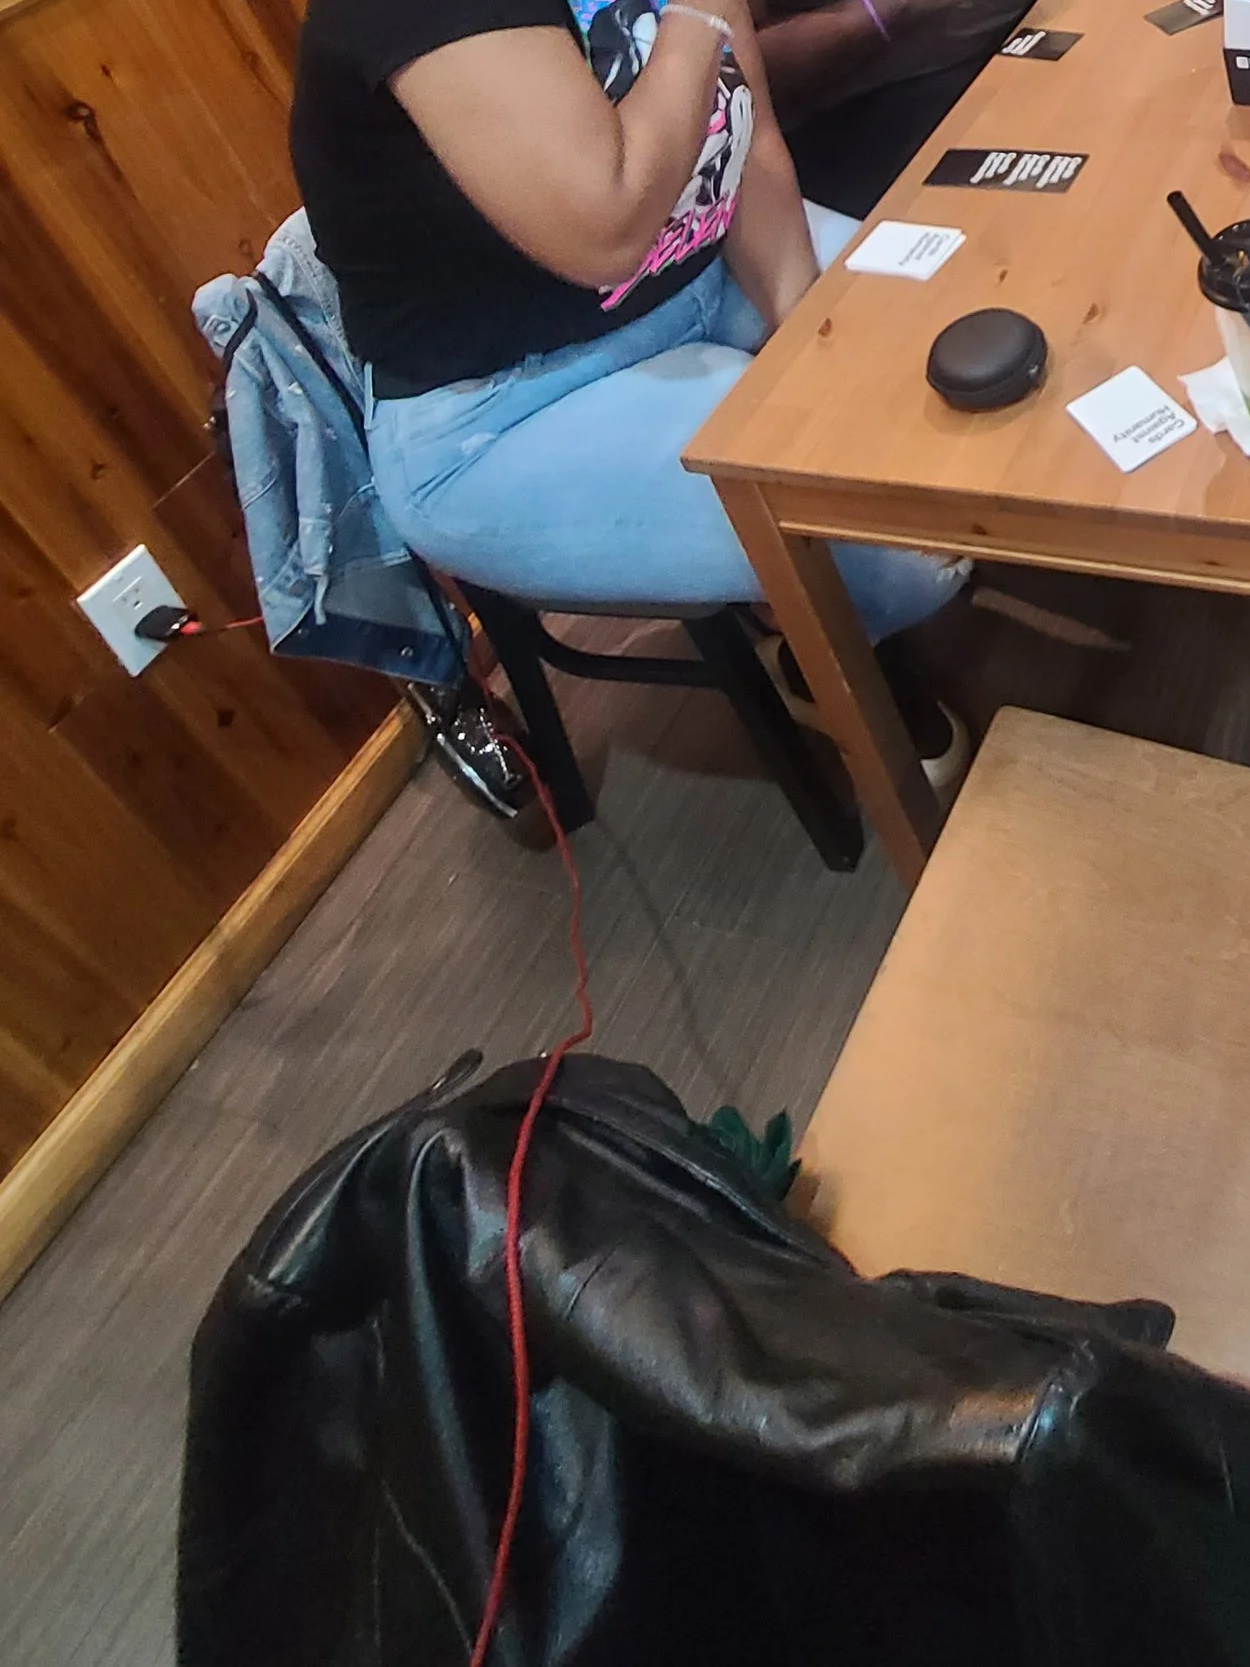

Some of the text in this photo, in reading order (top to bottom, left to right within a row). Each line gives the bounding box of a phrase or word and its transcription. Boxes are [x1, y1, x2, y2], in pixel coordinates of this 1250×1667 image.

[1113, 404, 1171, 443] Humanity
[1132, 411, 1176, 443] Against
[1148, 419, 1185, 443] Cards
